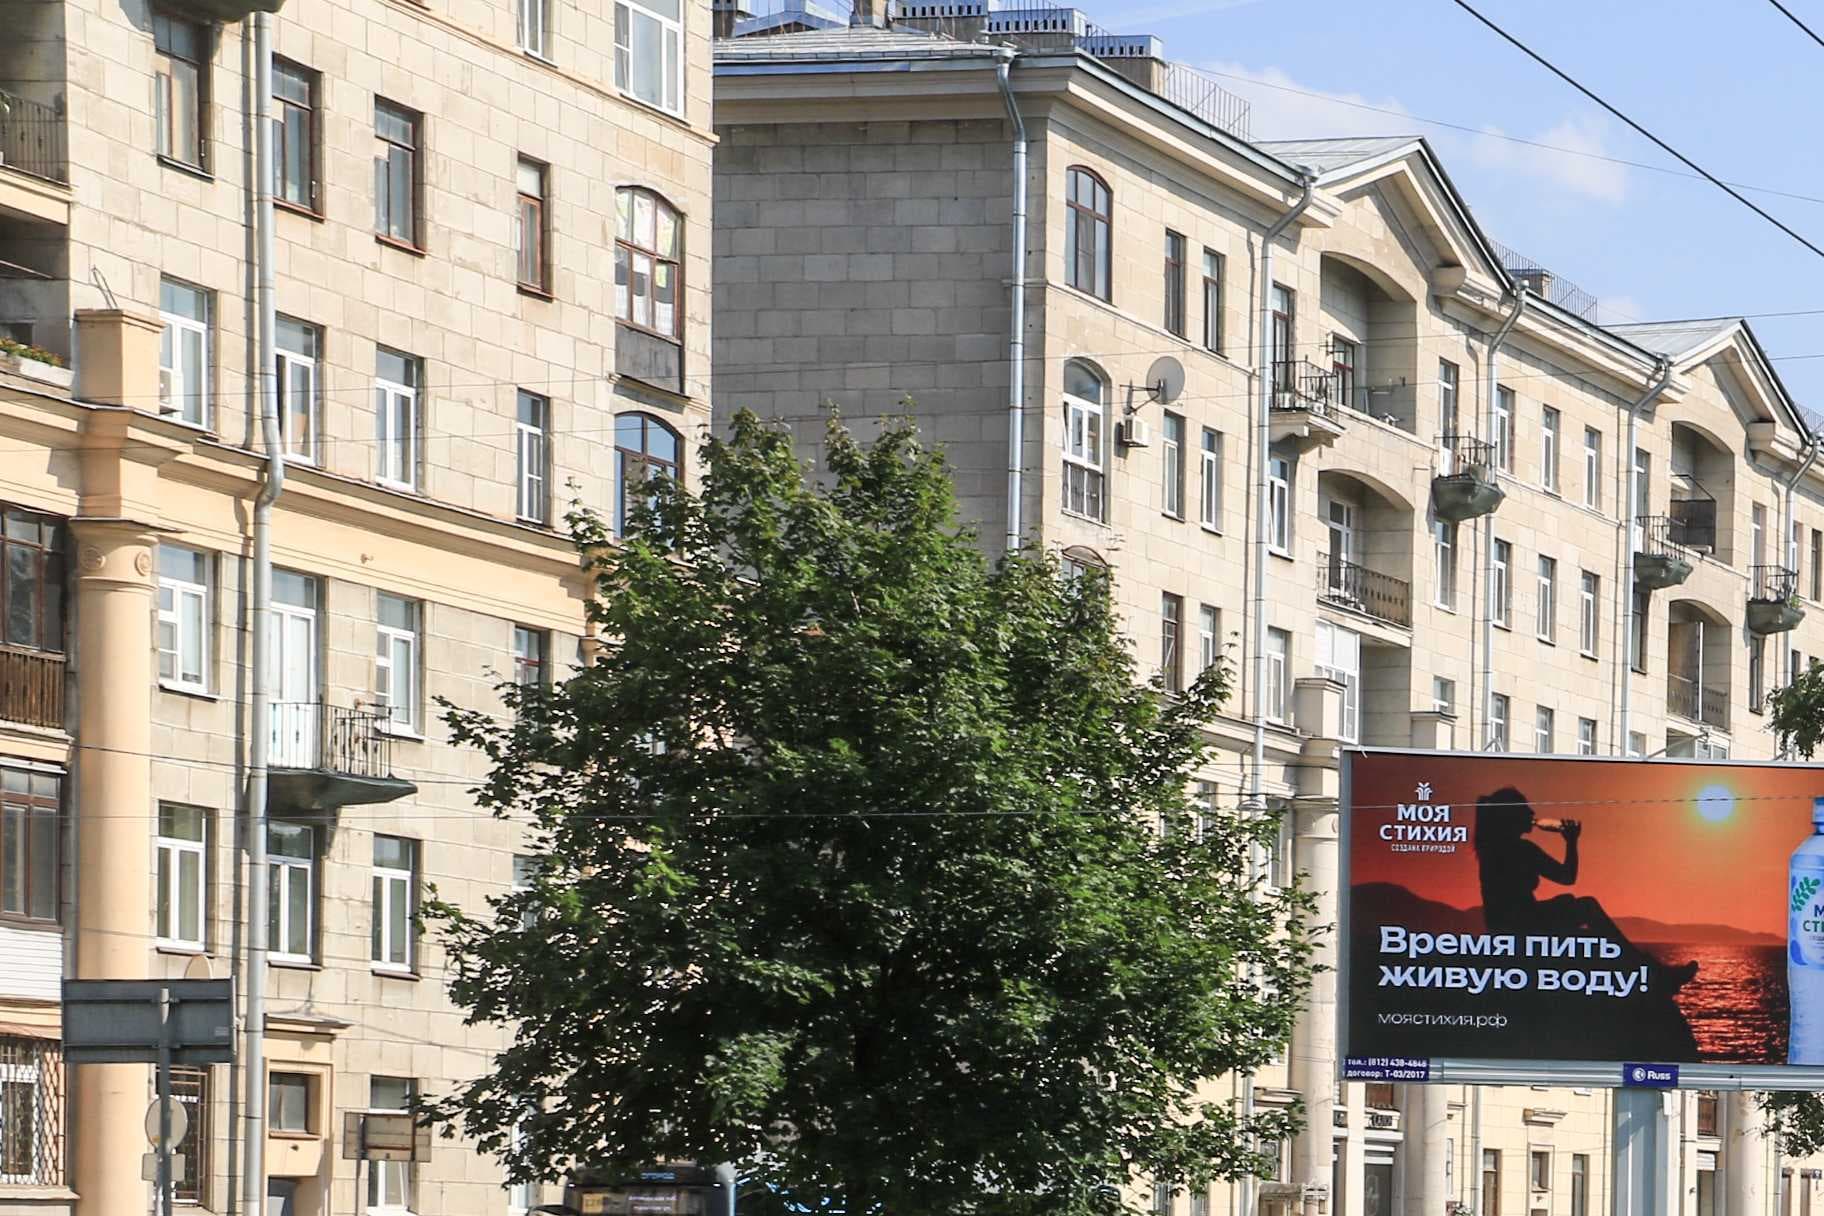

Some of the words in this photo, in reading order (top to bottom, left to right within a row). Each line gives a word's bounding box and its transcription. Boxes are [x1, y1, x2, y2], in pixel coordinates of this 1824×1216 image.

[1397, 803, 1450, 822] МОЯ
[1379, 824, 1468, 842] СТИХИЯ
[1379, 926, 1515, 958] Время
[1525, 935, 1622, 959] пить
[1378, 965, 1528, 994] живую
[1537, 965, 1649, 997] воду!
[1378, 1013, 1508, 1028] моястихия.рф
[1647, 1070, 1671, 1080] Russ
